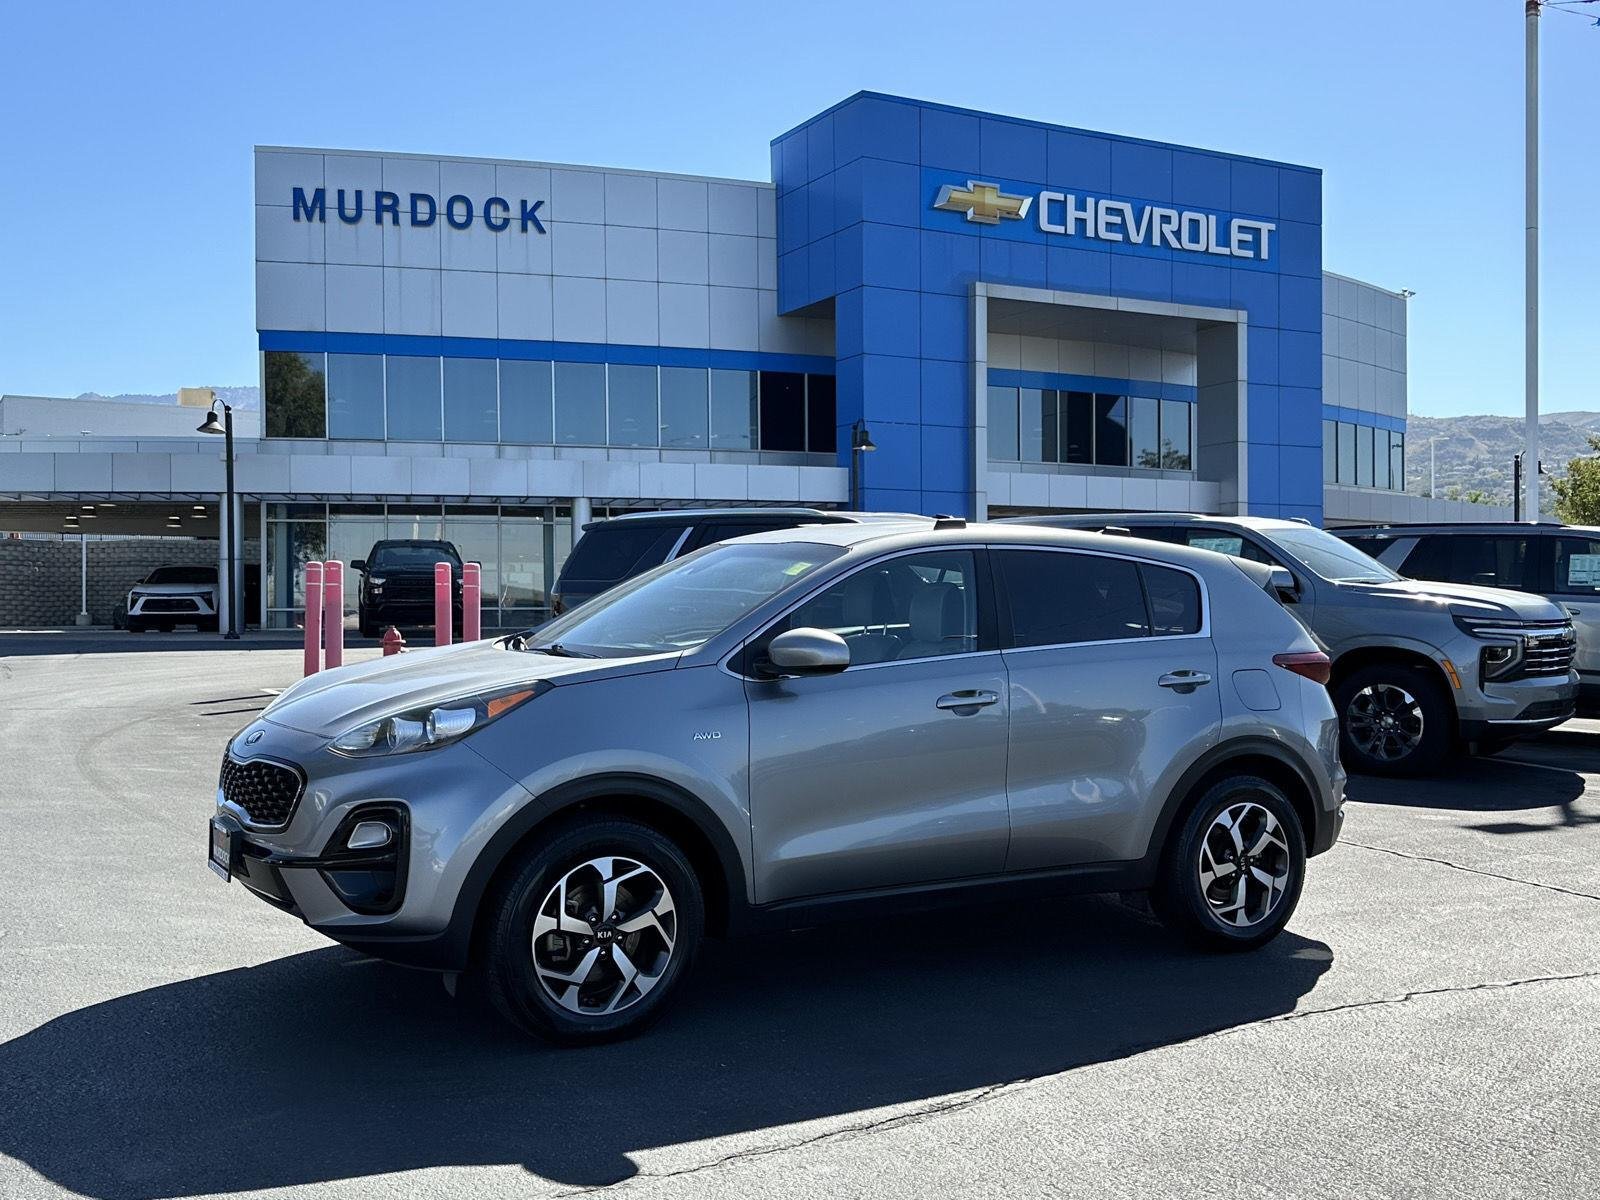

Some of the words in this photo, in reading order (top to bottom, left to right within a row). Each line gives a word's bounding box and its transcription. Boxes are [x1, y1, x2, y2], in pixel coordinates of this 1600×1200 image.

[292, 187, 547, 235] MURDOCK
[1038, 190, 1276, 260] CHEVROLET
[693, 731, 721, 741] AWD
[597, 931, 612, 939] KIA
